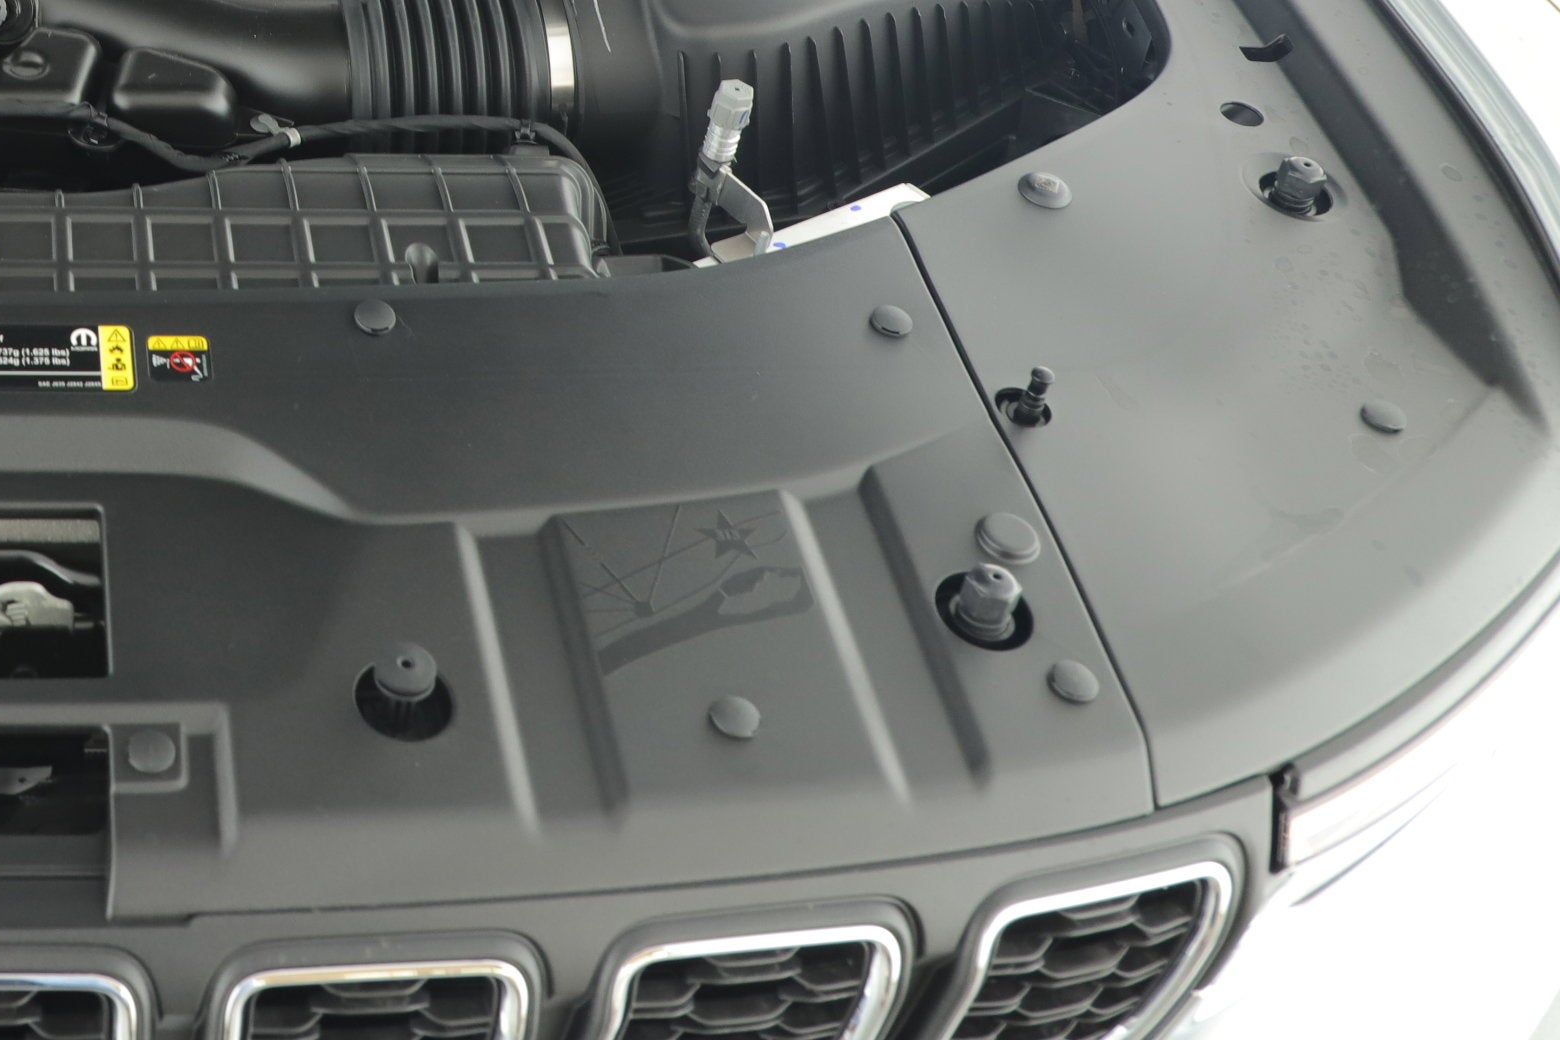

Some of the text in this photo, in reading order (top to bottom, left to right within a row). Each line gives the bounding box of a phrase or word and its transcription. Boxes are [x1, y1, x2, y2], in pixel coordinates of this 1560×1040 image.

[51, 348, 70, 358] lbs)
[21, 356, 51, 367] (1.375
[51, 356, 71, 367] lbs)
